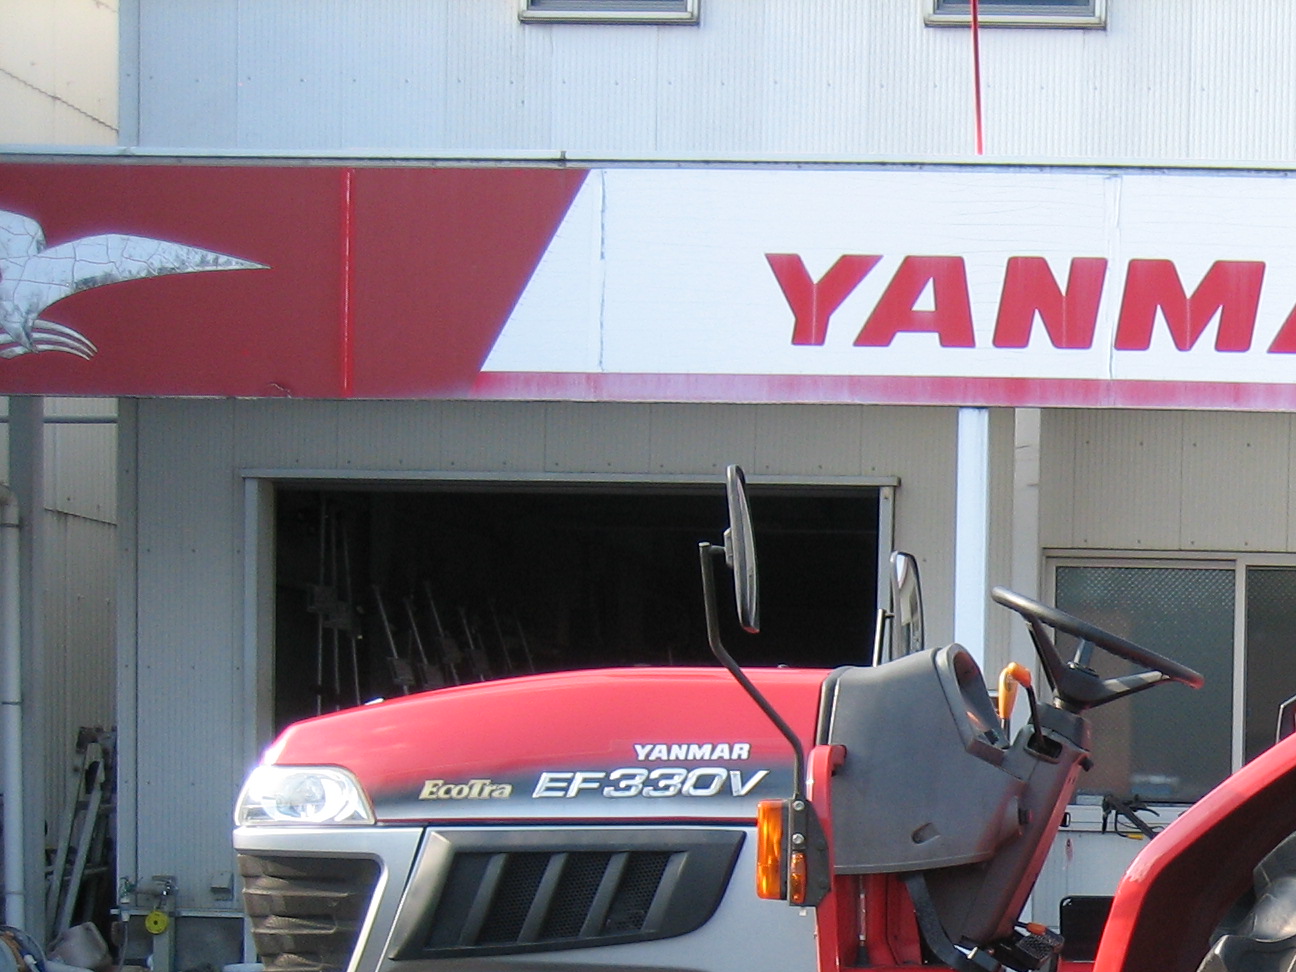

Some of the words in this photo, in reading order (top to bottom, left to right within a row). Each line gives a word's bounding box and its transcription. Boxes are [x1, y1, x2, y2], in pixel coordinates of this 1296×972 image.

[633, 742, 751, 762] YANMAR
[418, 778, 513, 801] EcoTra
[532, 766, 770, 799] EF330V
